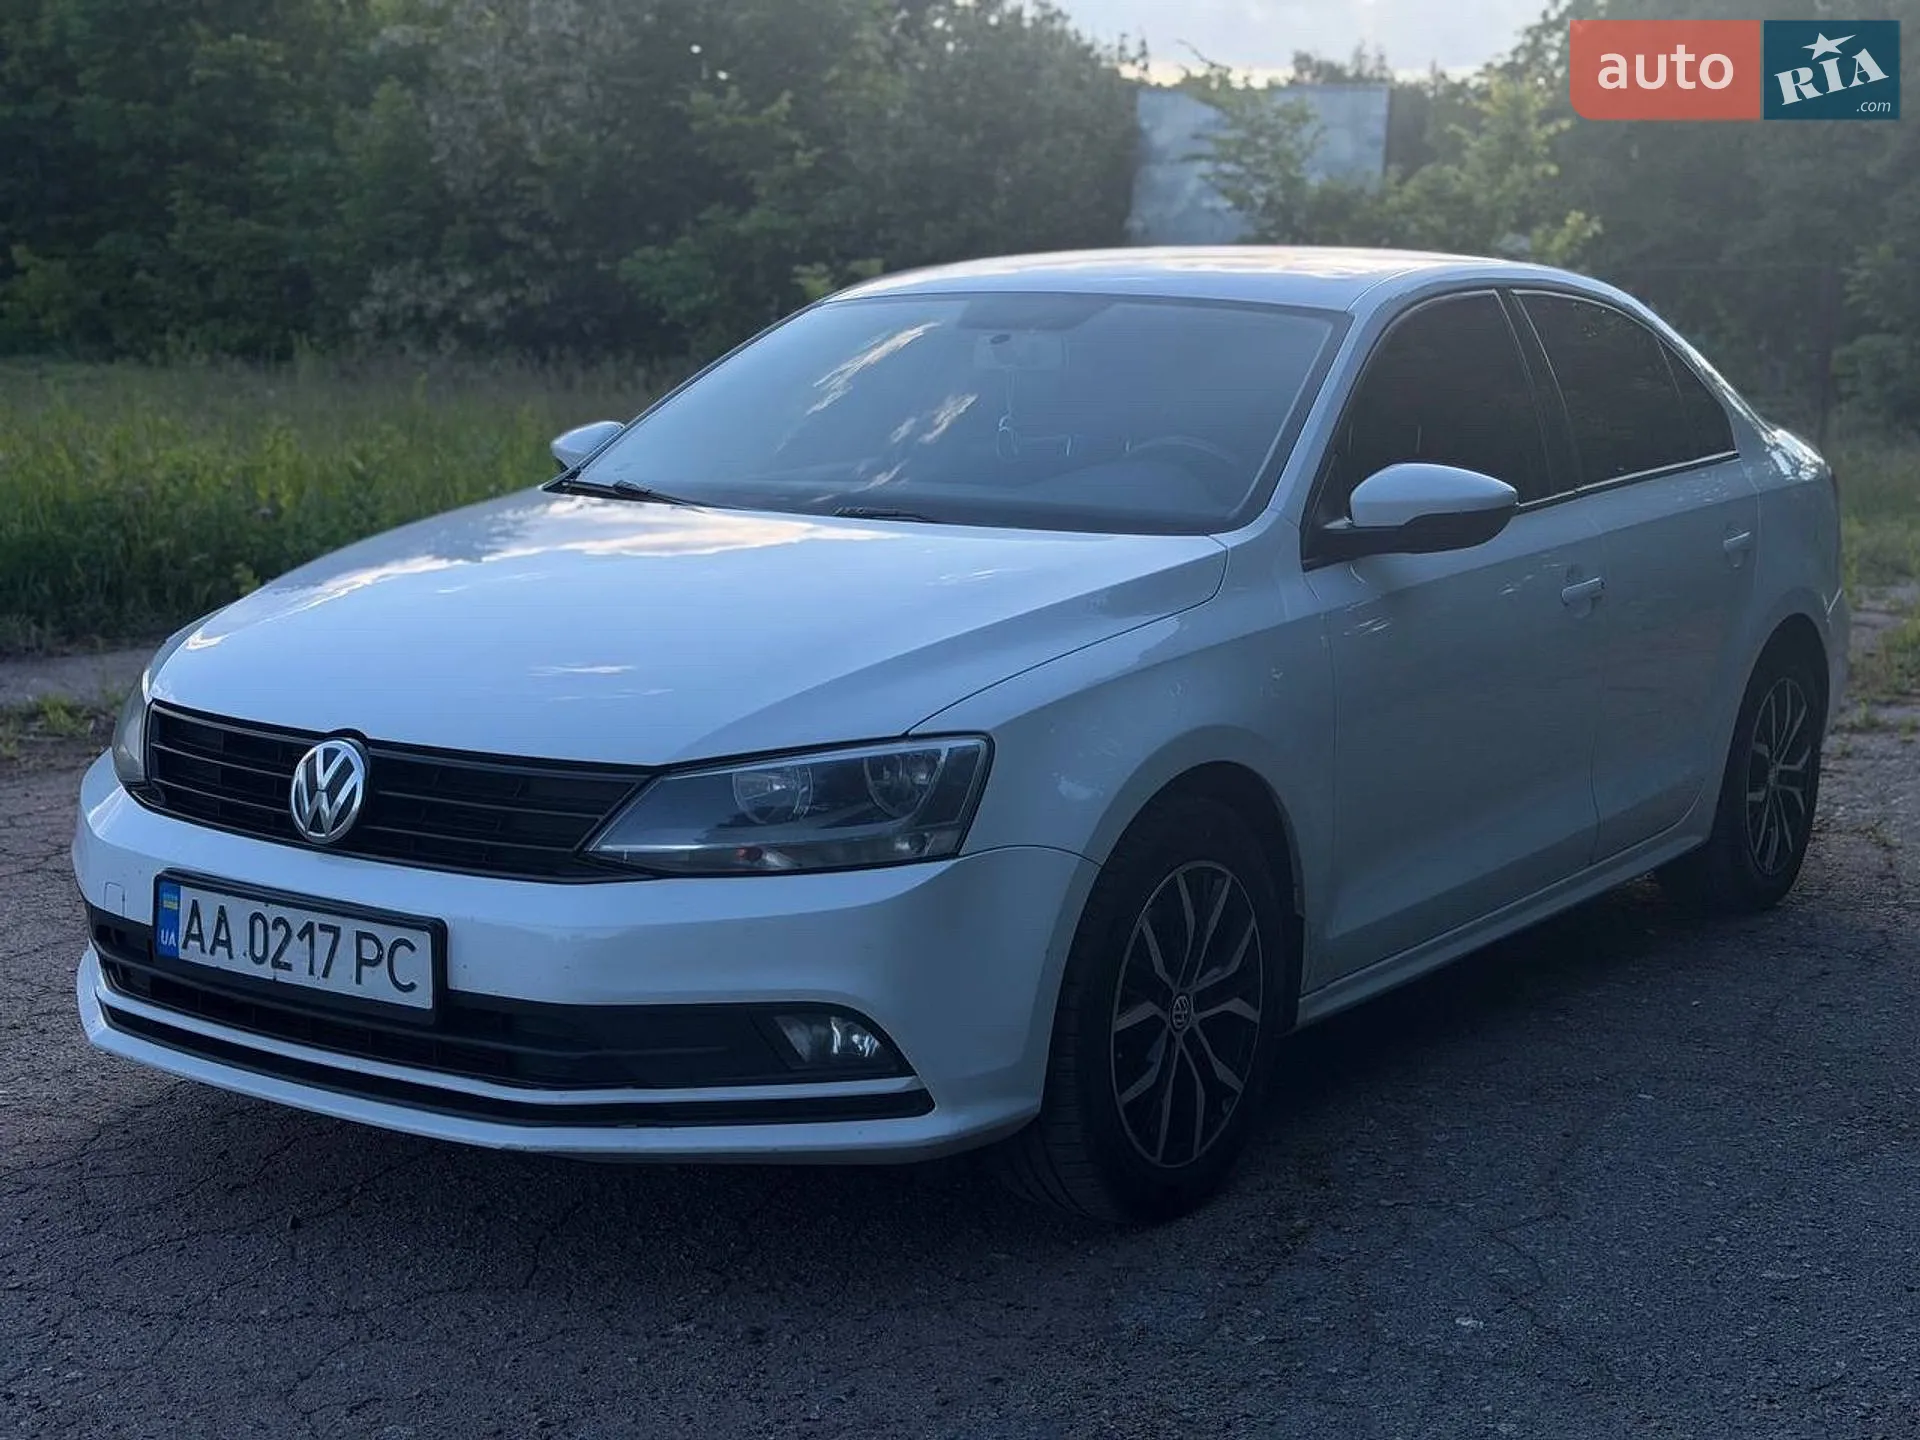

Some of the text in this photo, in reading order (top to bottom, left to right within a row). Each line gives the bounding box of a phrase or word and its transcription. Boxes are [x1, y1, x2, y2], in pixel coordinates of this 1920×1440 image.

[159, 928, 177, 948] UA
[181, 899, 418, 993] AA 0217 PC
